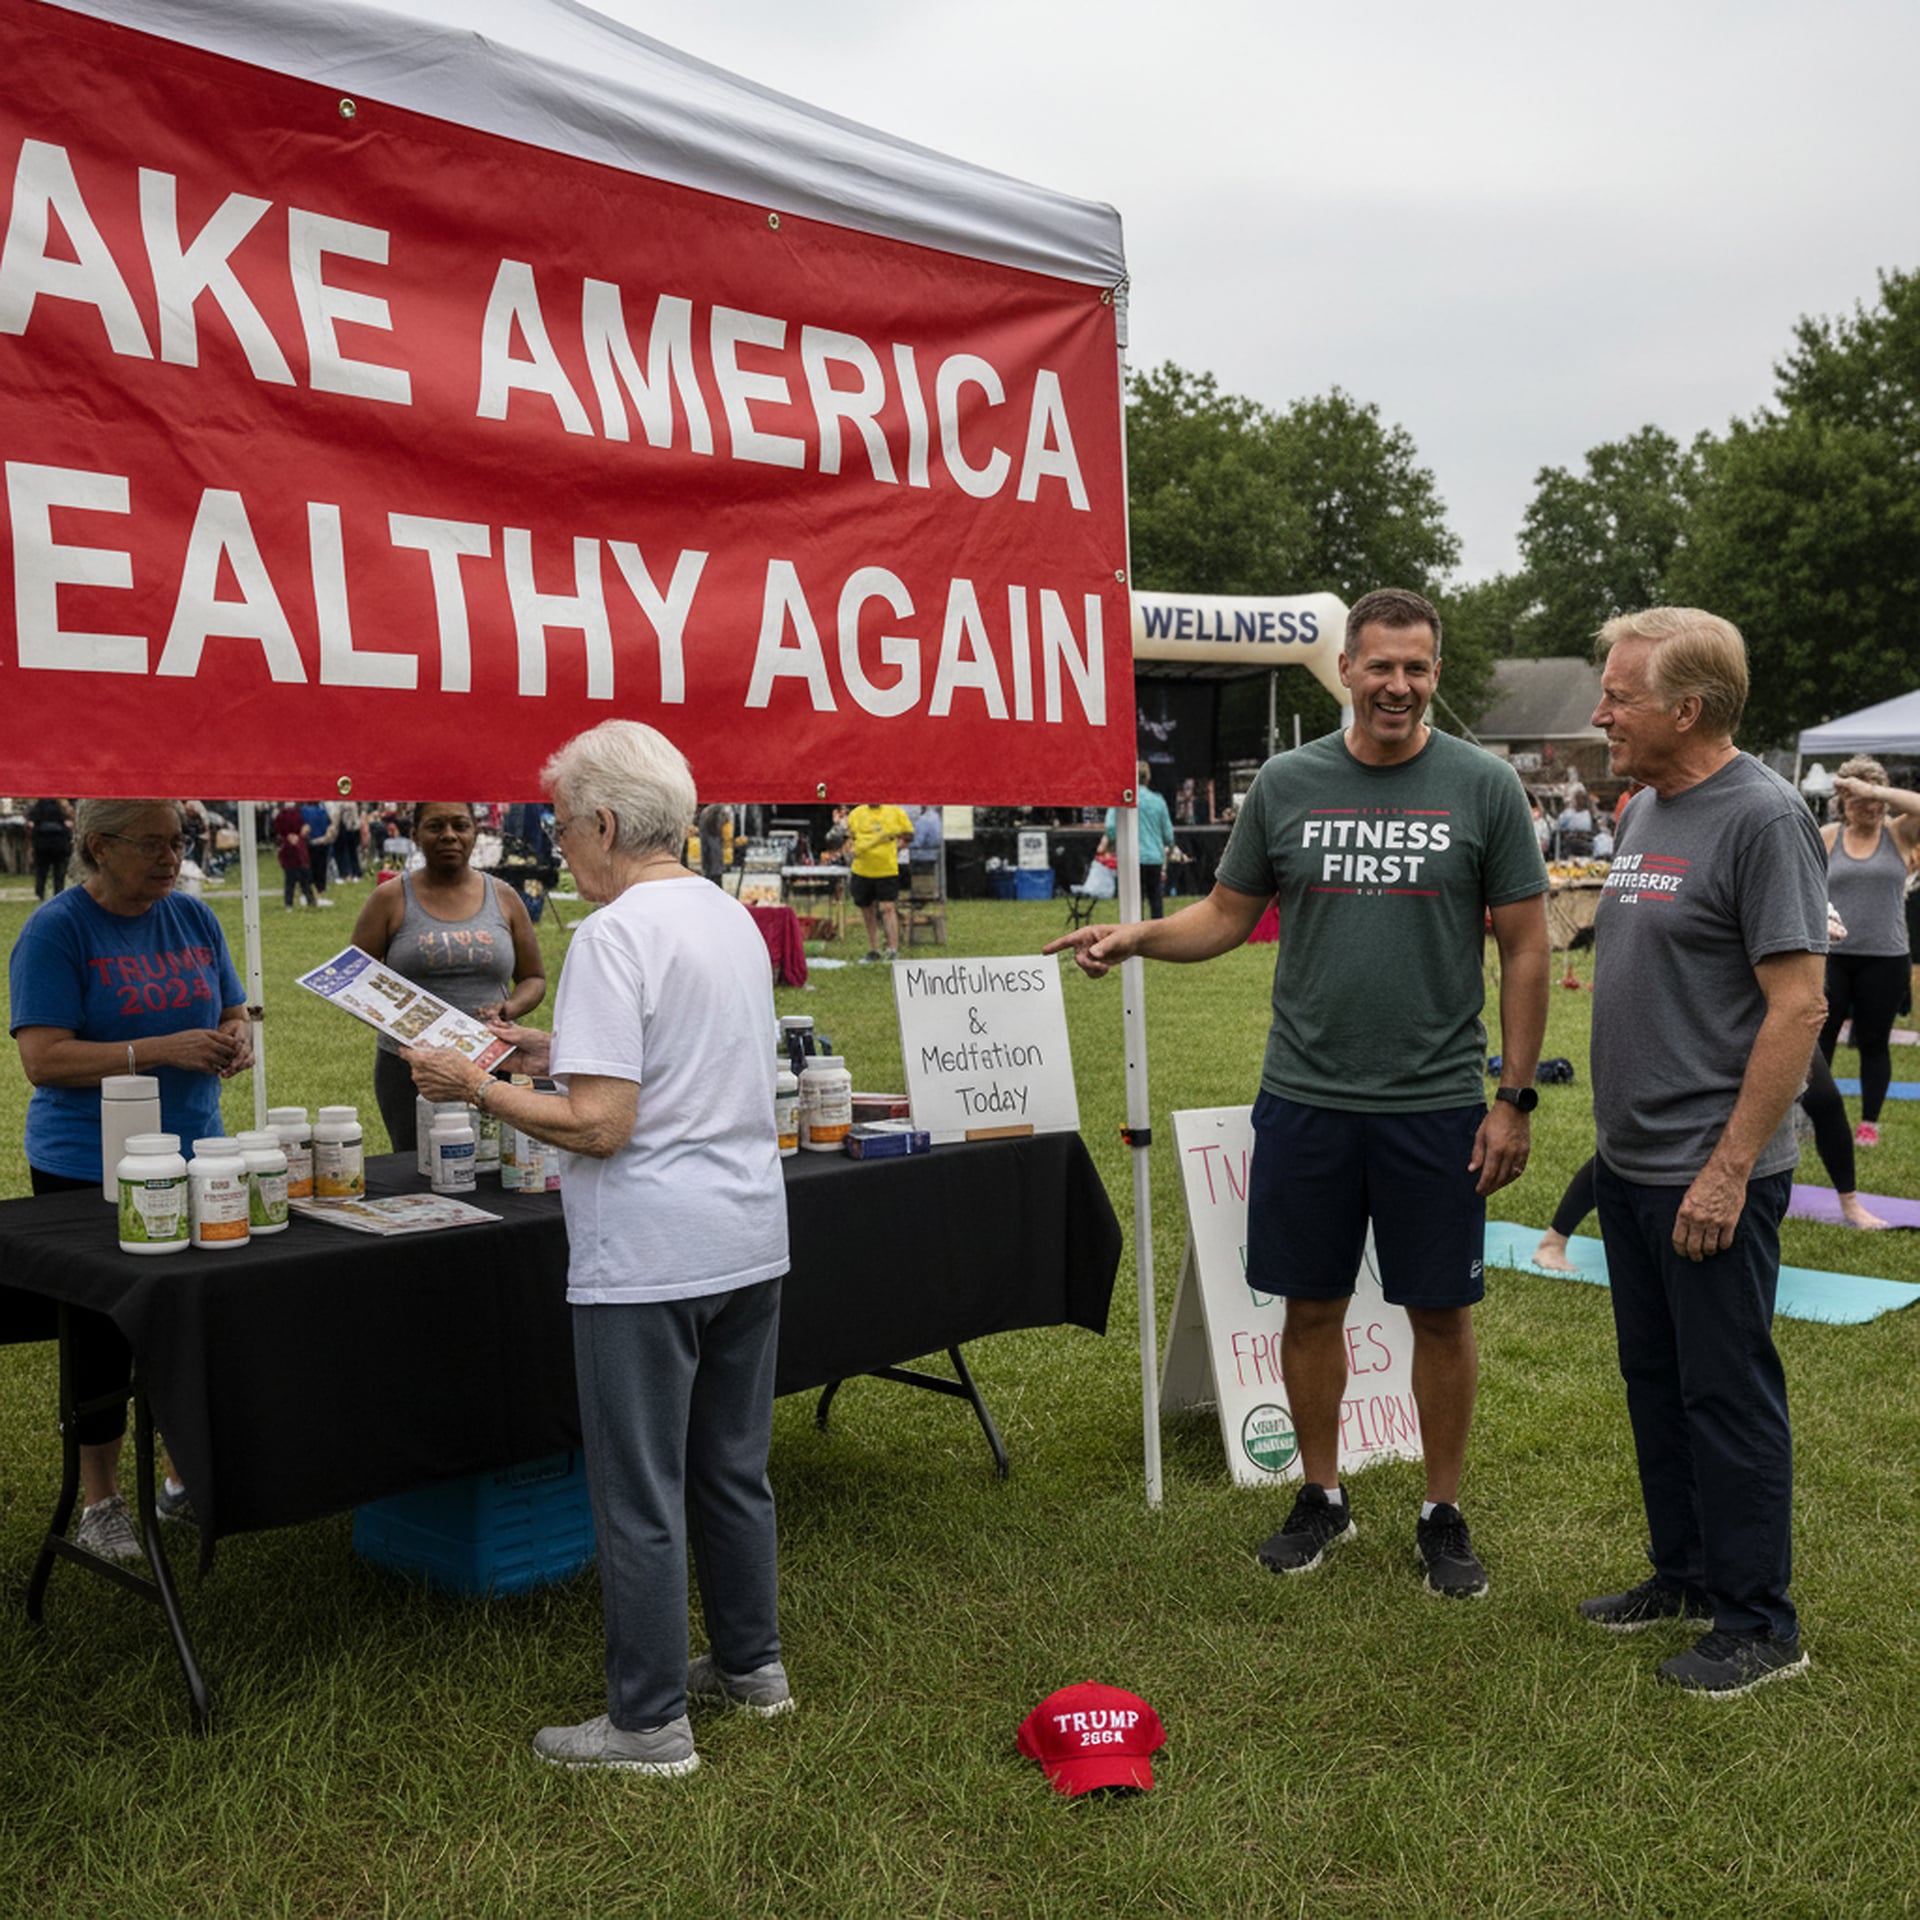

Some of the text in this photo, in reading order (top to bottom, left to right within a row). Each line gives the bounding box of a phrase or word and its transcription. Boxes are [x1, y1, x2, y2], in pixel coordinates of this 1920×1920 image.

[476, 259, 1091, 512] AMERICA
[0, 461, 1107, 726] EALTHY AGAIN
[1142, 606, 1319, 644] WELLNESS
[1302, 820, 1451, 852] FITNESS
[1322, 854, 1425, 884] FIRST
[906, 965, 1046, 998] Mindfulness
[968, 1006, 988, 1035] &
[954, 1081, 1029, 1116] Today
[1053, 1709, 1140, 1733] TRUMP
